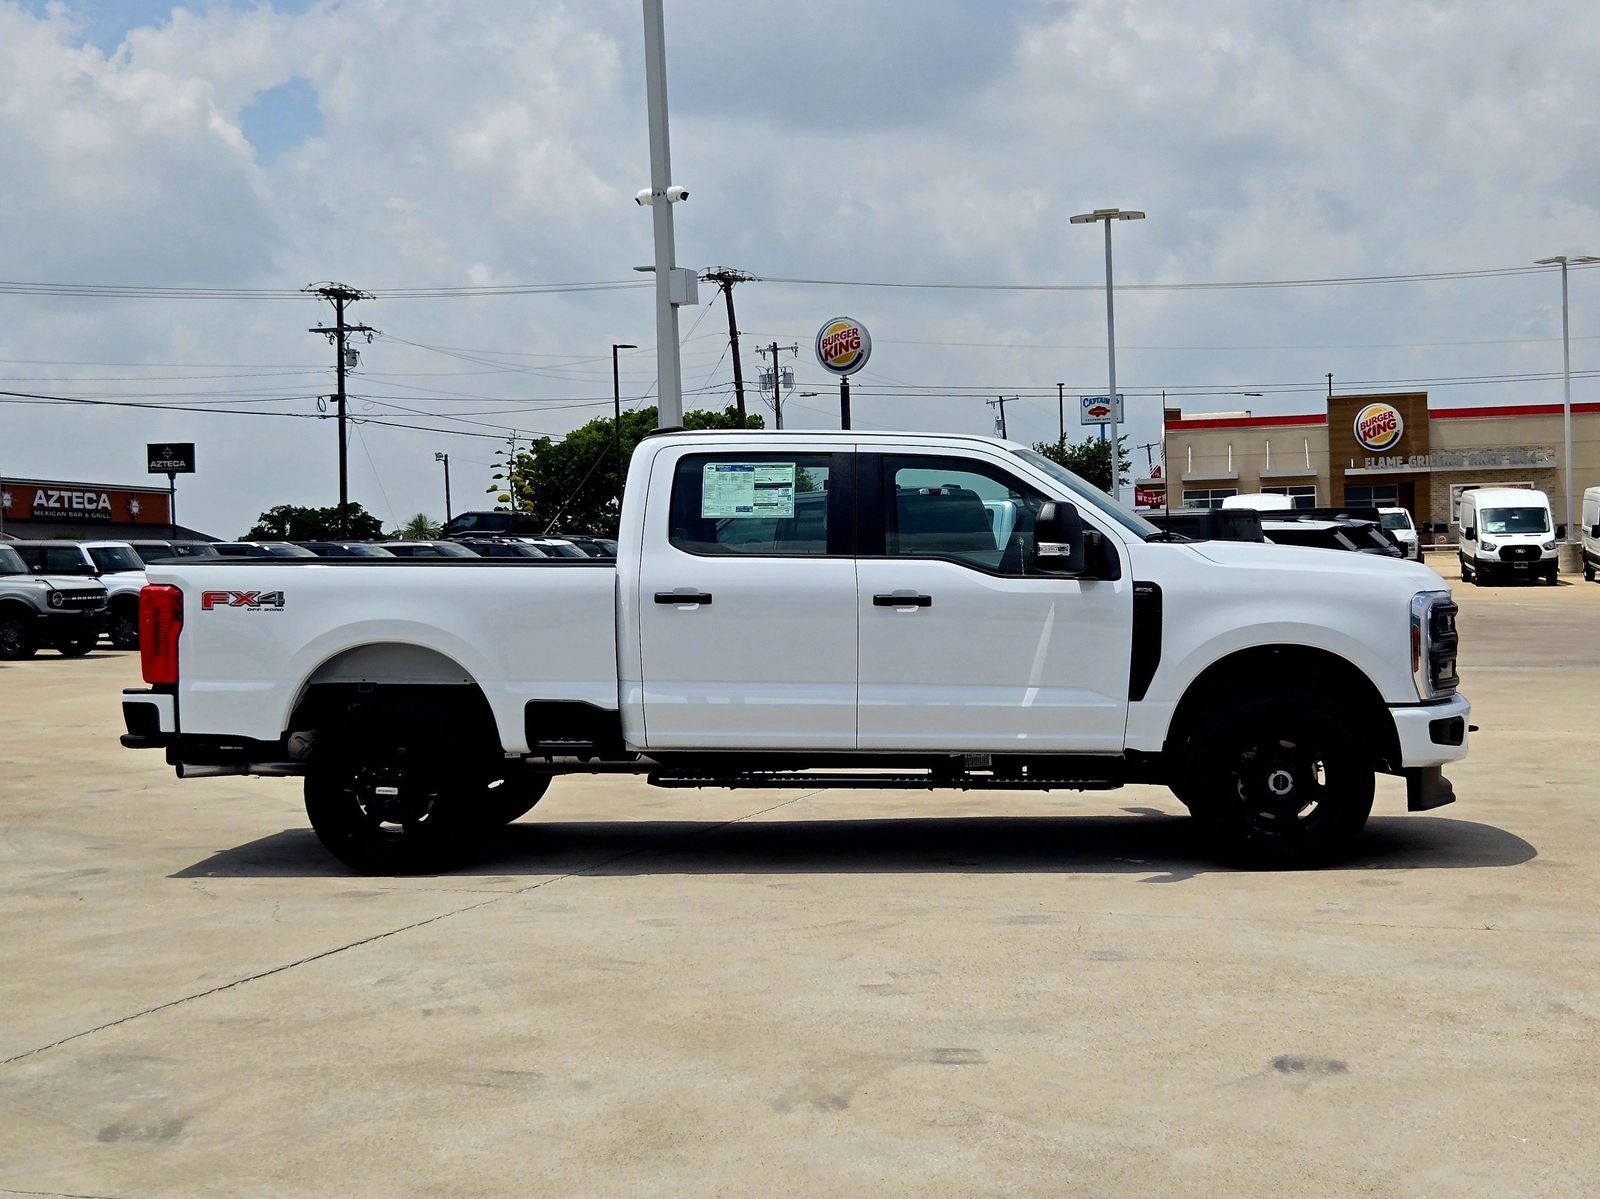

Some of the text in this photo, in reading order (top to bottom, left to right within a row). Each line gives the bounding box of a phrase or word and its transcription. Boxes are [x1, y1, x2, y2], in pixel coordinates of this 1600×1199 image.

[822, 328, 859, 349] BURGER
[824, 336, 861, 362] KING
[1360, 411, 1394, 431] BURGER
[1362, 418, 1397, 442] KING
[150, 460, 186, 468] AZTECA
[1364, 456, 1403, 470] FLAME
[33, 489, 112, 510] AZTECA
[201, 590, 286, 611] FX4
